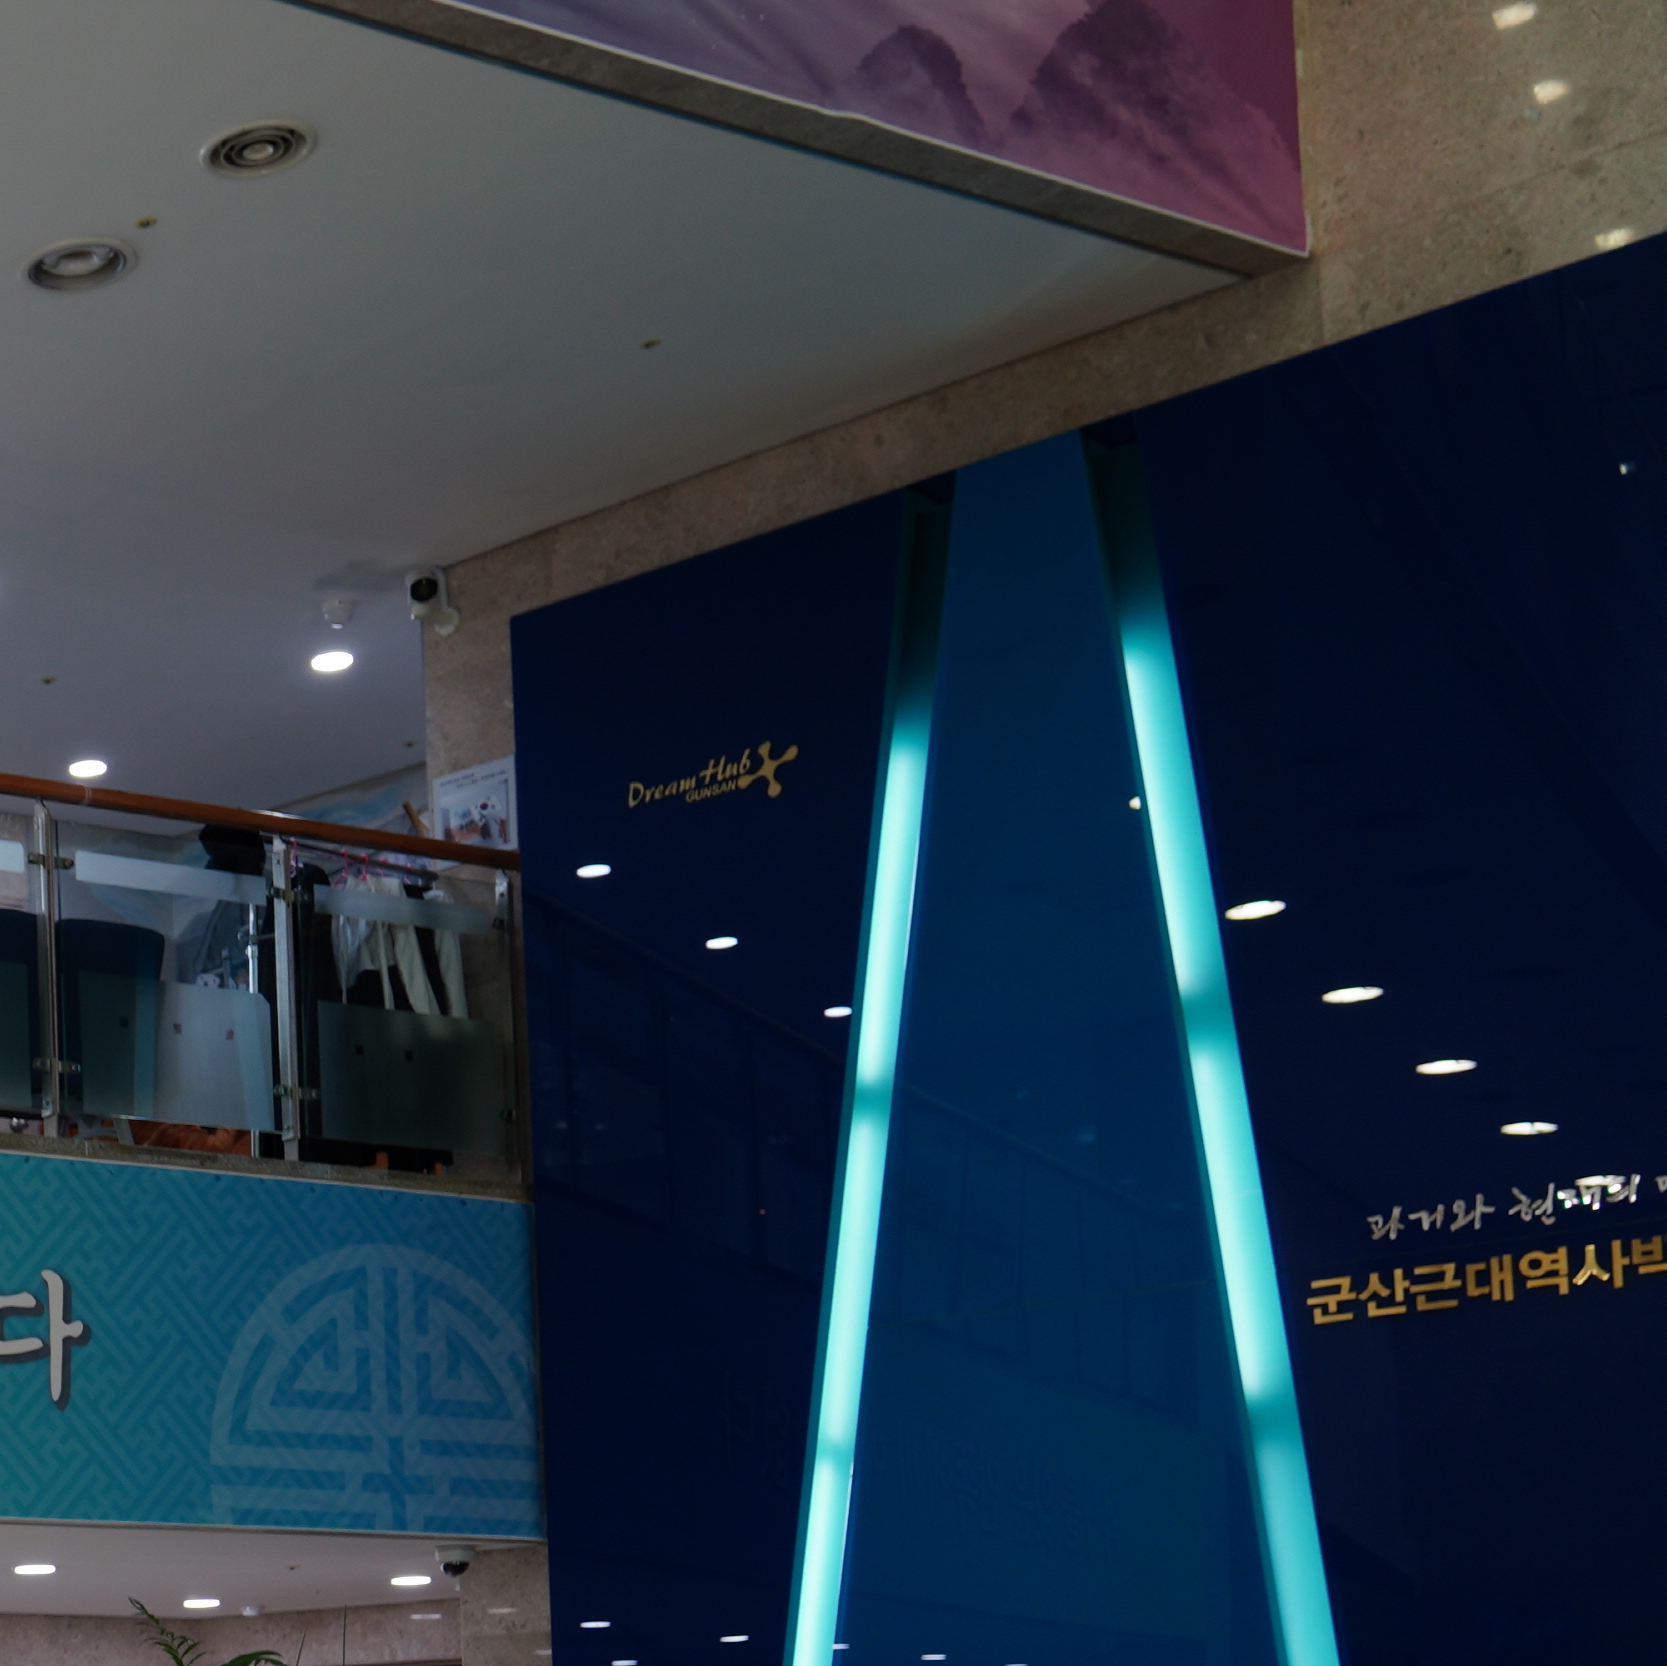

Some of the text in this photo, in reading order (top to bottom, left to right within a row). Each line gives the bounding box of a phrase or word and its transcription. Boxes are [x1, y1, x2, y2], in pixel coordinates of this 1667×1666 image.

[628, 747, 751, 808] Dream Hub
[685, 779, 738, 803] GUNSAN
[1367, 1173, 1641, 1241] 과거와 현재의
